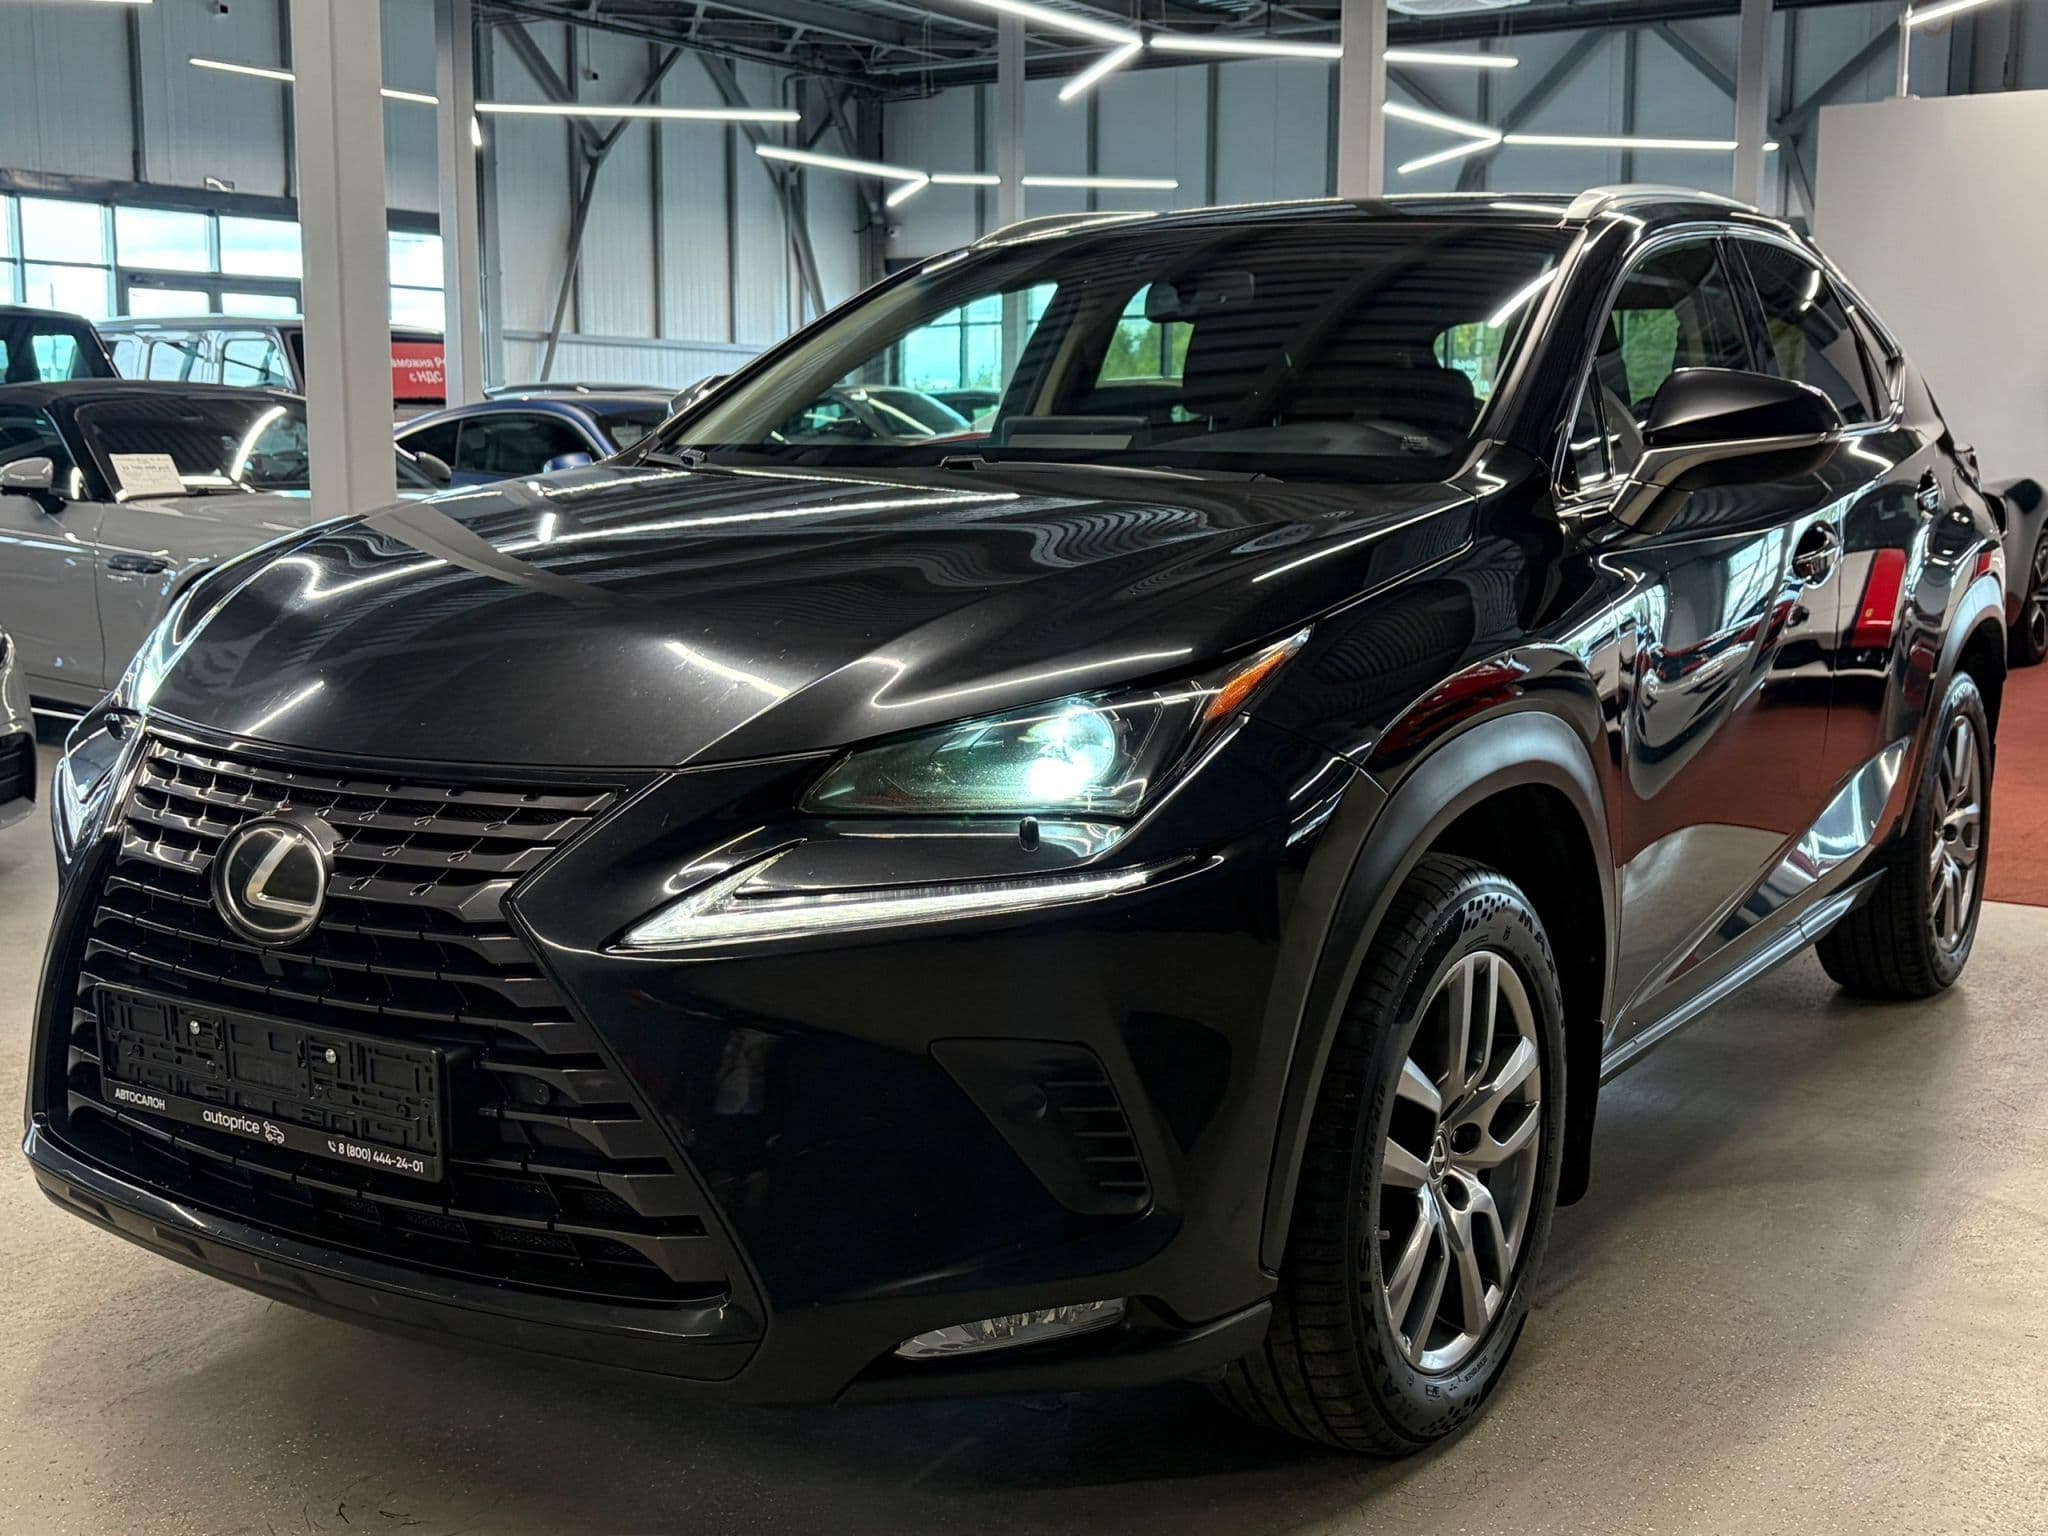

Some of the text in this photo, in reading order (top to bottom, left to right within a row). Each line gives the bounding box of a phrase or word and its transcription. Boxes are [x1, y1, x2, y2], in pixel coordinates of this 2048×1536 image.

[416, 369, 443, 384] НДС
[114, 1087, 166, 1111] АВТОСАЛОН
[203, 1110, 260, 1134] autoprice
[338, 1143, 424, 1174] 8 (800) 444-24-01
